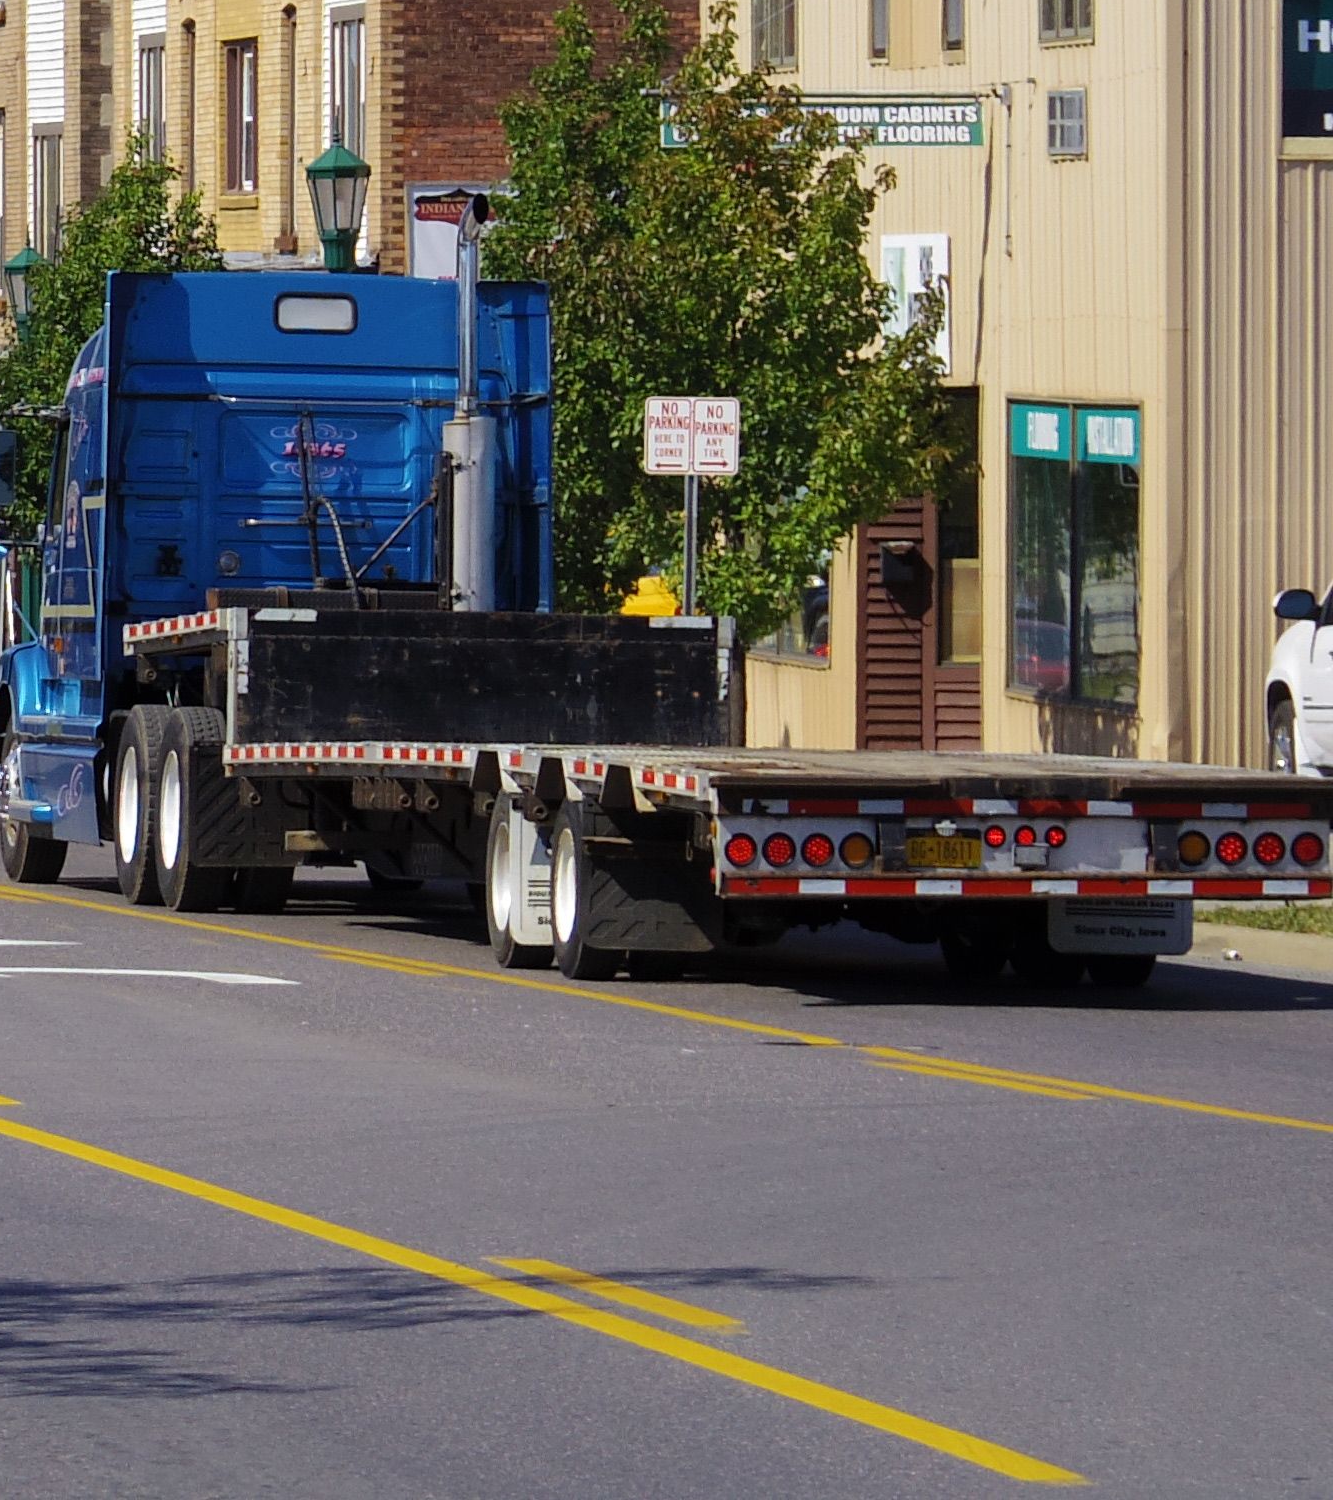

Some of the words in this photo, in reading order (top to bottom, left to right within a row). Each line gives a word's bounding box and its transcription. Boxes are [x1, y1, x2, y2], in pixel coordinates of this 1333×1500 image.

[883, 106, 978, 122] CABINETS
[877, 125, 971, 142] FLOORING
[661, 402, 679, 415] NO
[706, 405, 723, 418] NO
[649, 416, 690, 430] PARKING
[695, 421, 735, 435] PARKING
[654, 434, 672, 443] HERE
[676, 434, 685, 443] TO
[706, 438, 723, 447] ANY
[654, 448, 683, 458] CORNER
[704, 449, 725, 458] TIME
